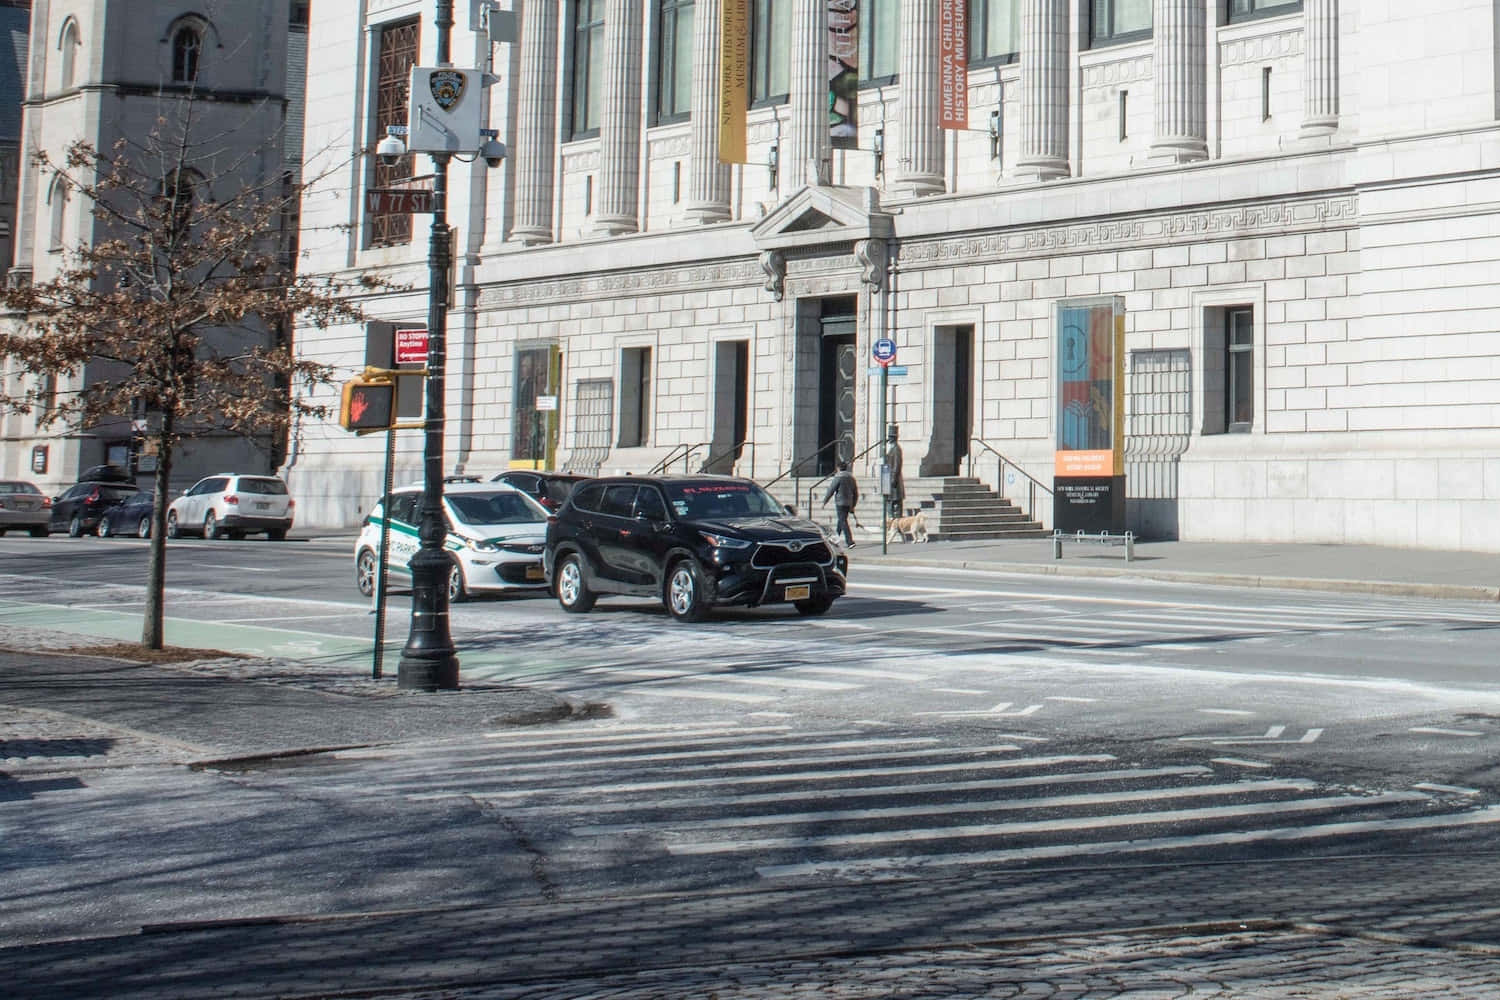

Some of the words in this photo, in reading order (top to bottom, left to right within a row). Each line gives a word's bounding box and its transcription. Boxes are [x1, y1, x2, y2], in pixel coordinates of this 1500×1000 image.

[955, 0, 965, 60] MUSEUM
[723, 64, 733, 96] YORK
[736, 38, 745, 89] MUSEUM
[943, 55, 953, 121] DIMENNA
[955, 64, 965, 121] HISTORY
[369, 193, 381, 211] W
[388, 193, 405, 211] 77
[411, 193, 427, 211] ST
